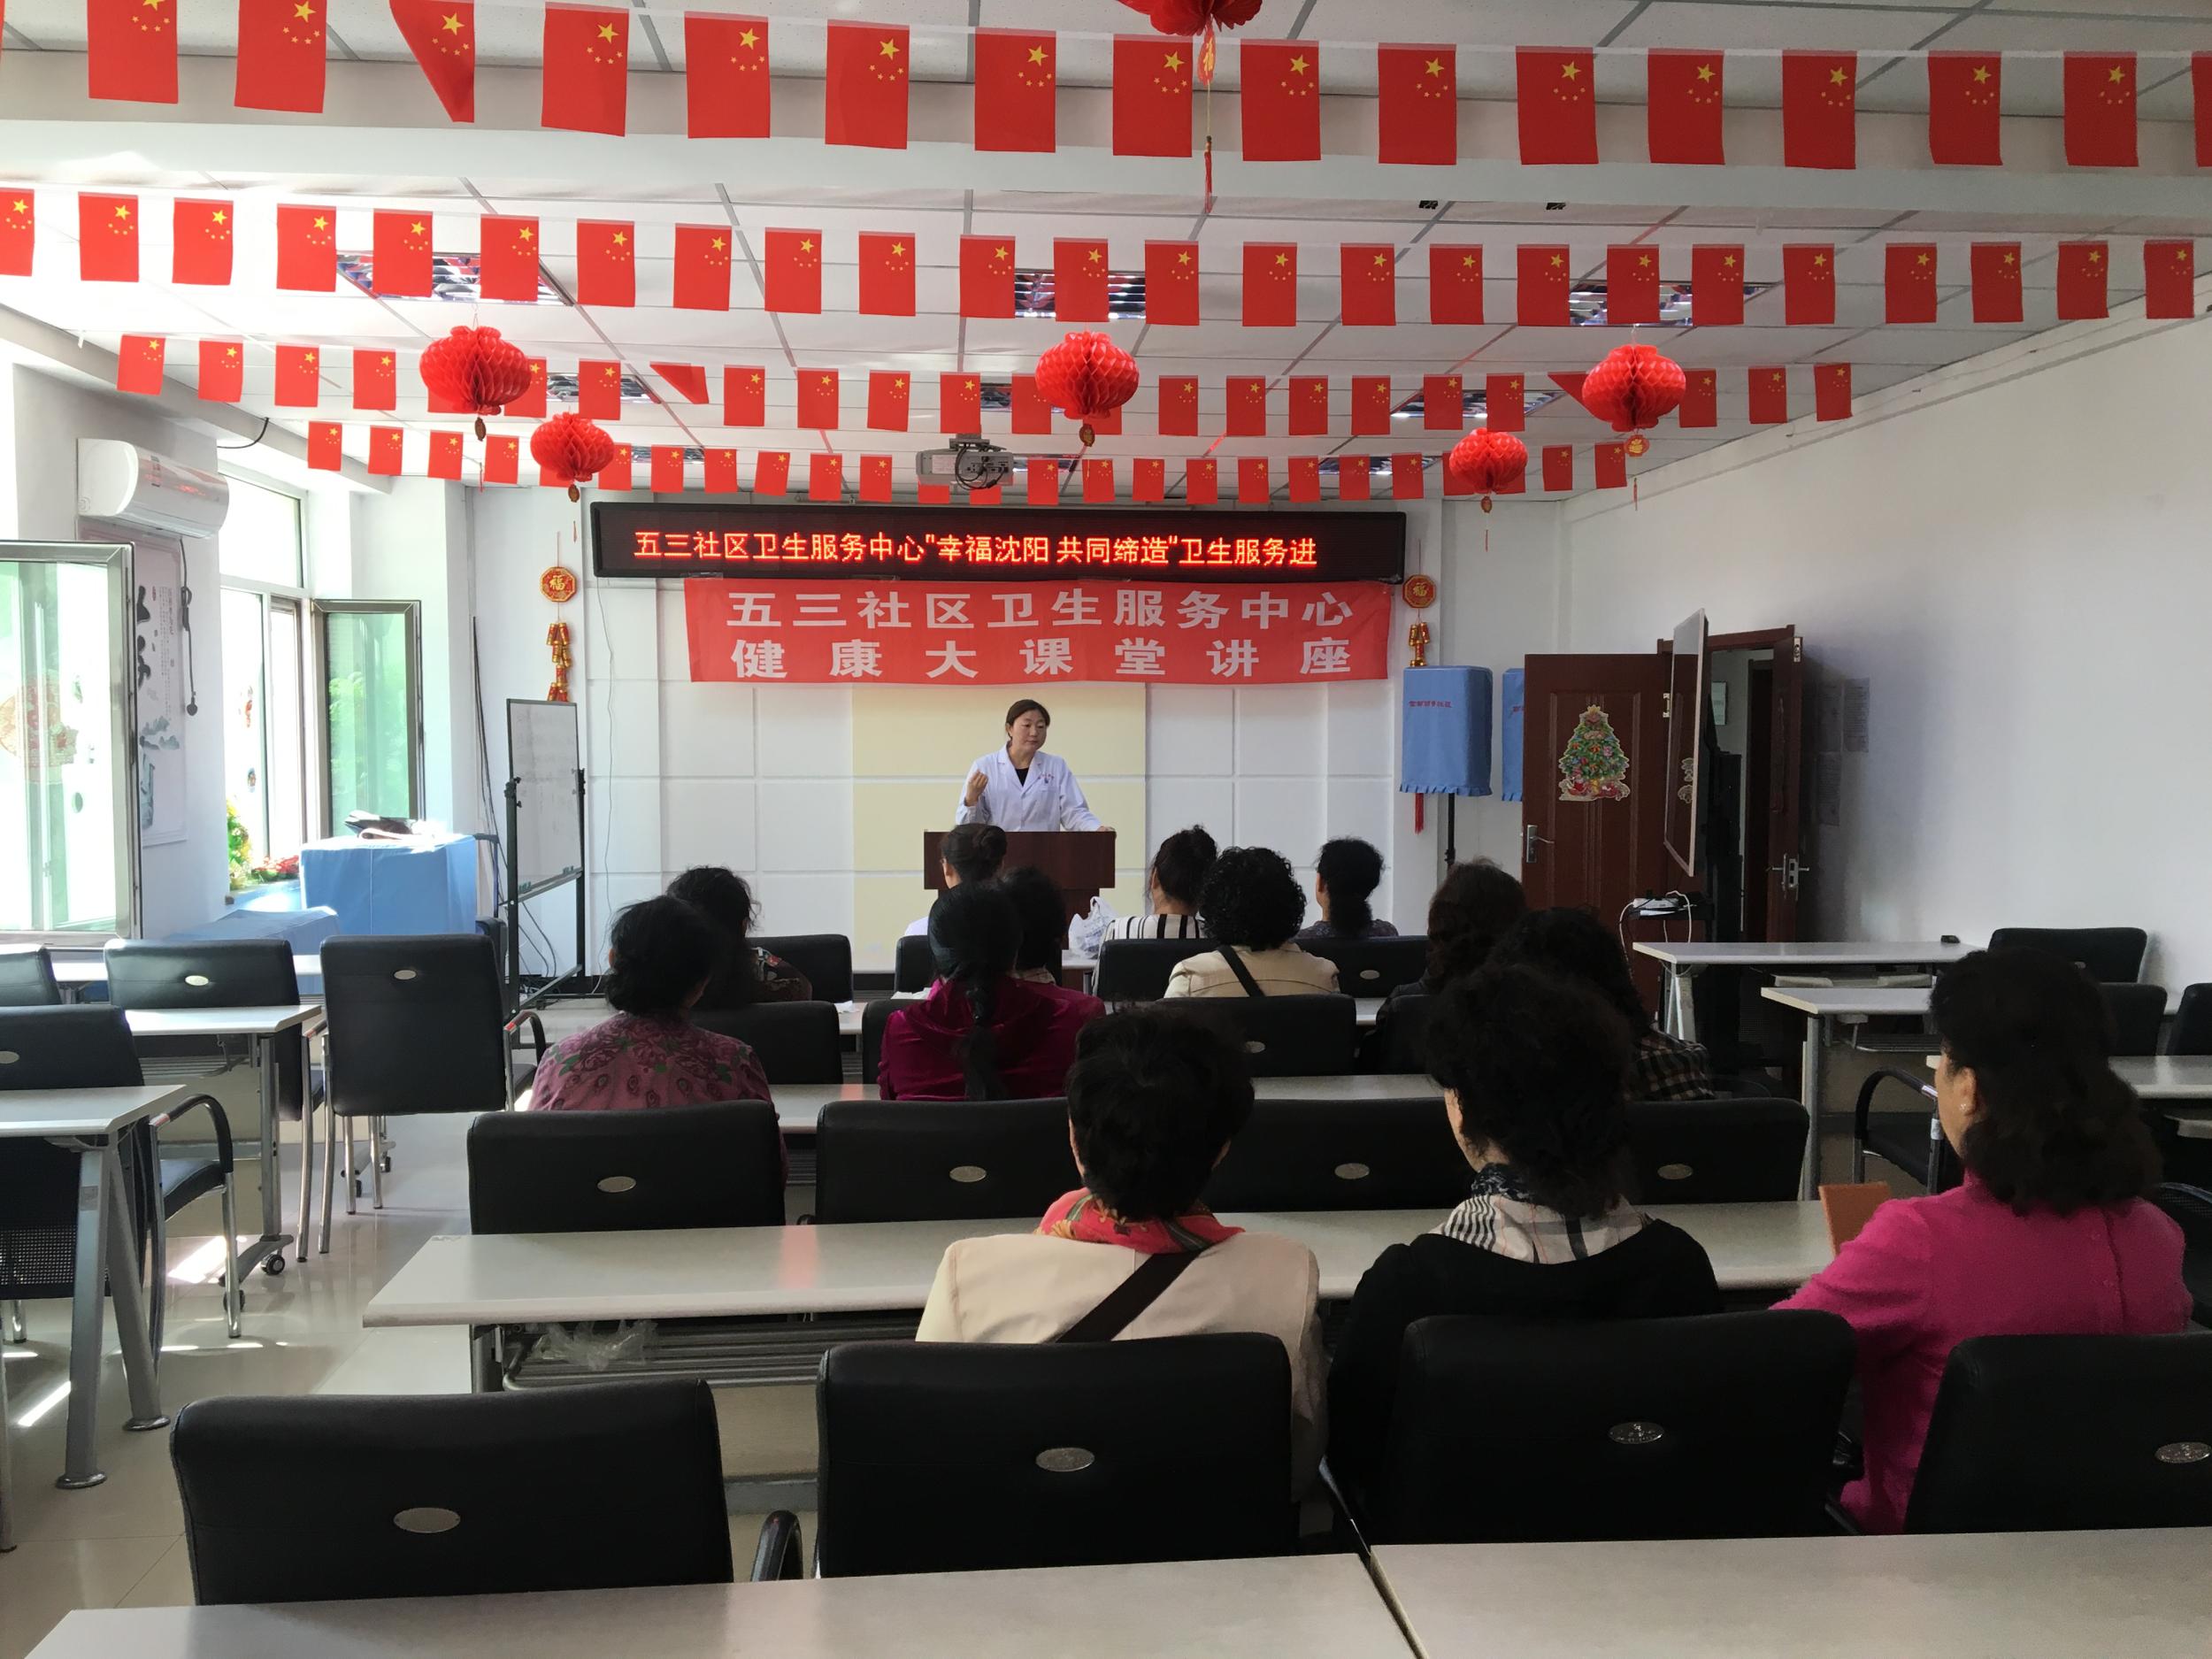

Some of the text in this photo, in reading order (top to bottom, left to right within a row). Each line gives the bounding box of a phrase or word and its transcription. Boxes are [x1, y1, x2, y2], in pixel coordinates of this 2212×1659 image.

[549, 575, 565, 590] 福
[726, 588, 1354, 629] 五三社区卫生服务中心
[731, 637, 1351, 679] 健康大课堂讲座
